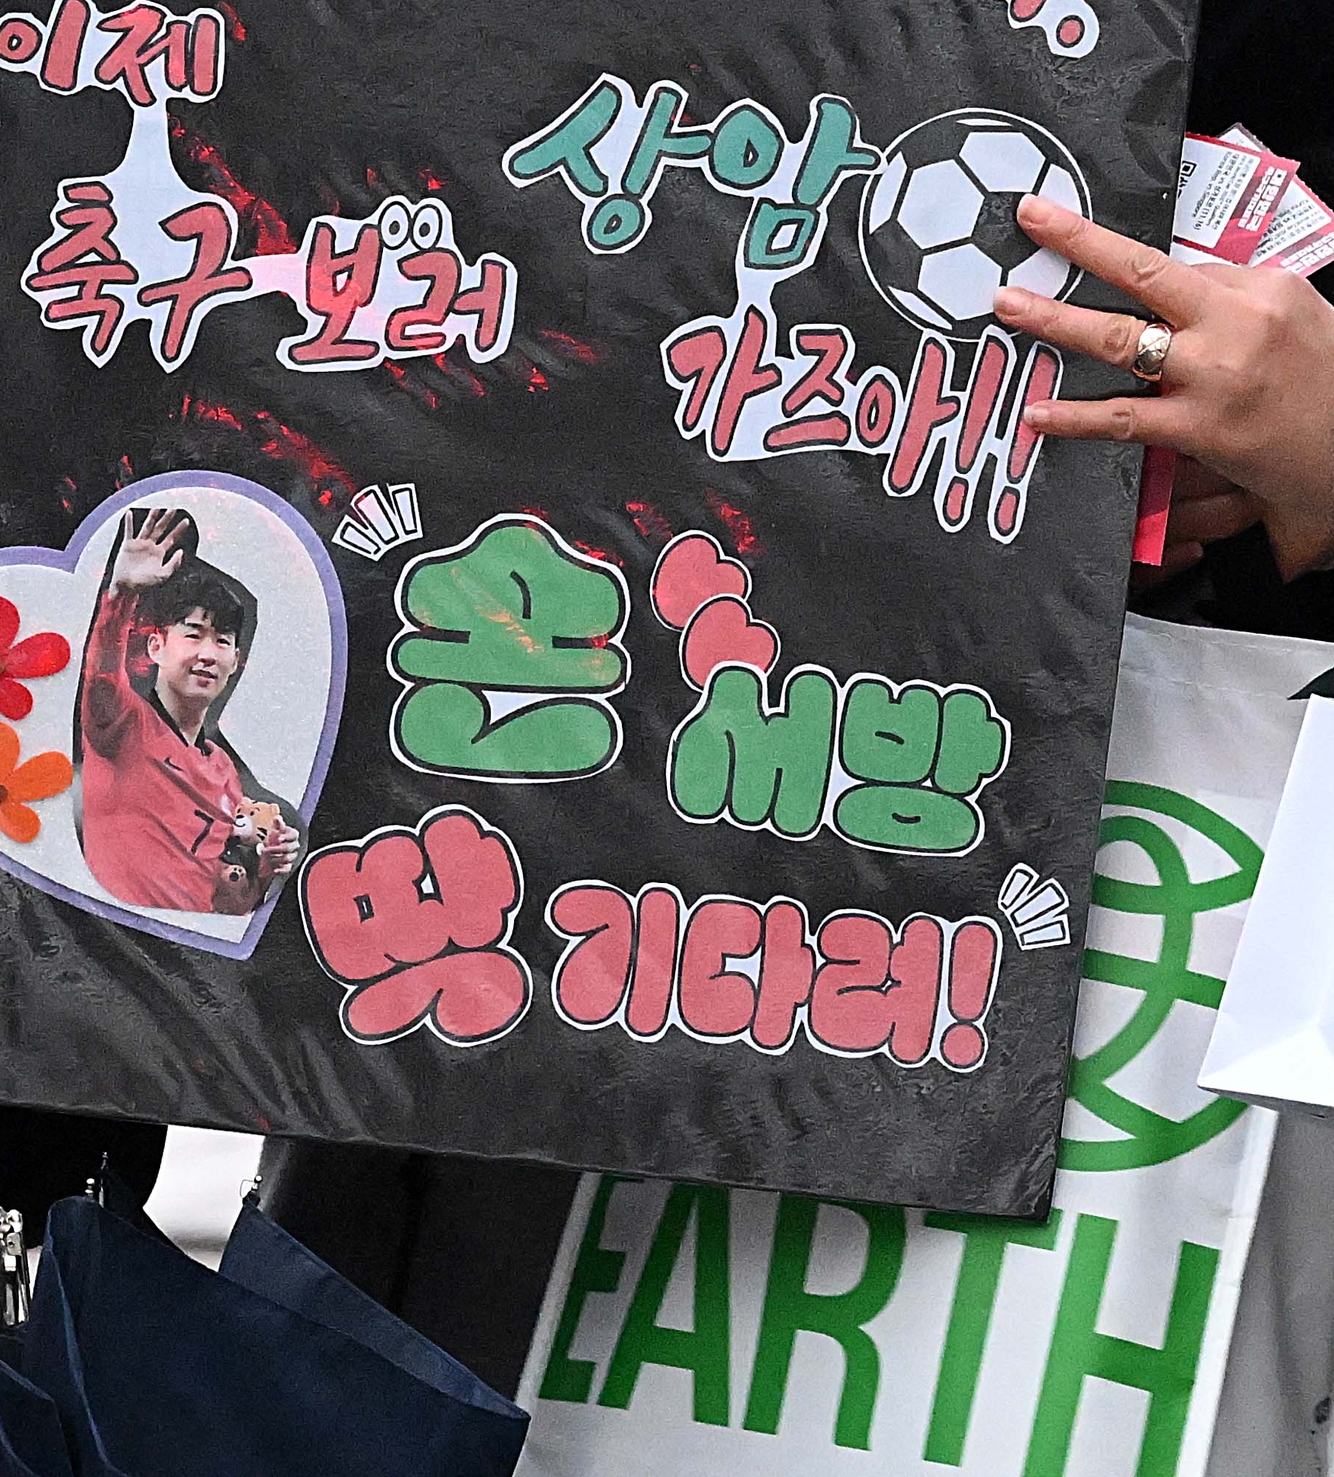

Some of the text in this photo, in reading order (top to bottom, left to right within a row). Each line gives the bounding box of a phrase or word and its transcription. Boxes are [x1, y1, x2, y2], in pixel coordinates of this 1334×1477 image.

[26, 182, 510, 365] 축구 보러
[508, 82, 881, 270] 상암
[665, 305, 1062, 539] 가즈아!!
[393, 520, 1006, 854] 손 서방
[547, 881, 1003, 1071] 기다려!
[538, 1173, 1222, 1477] EARTH
